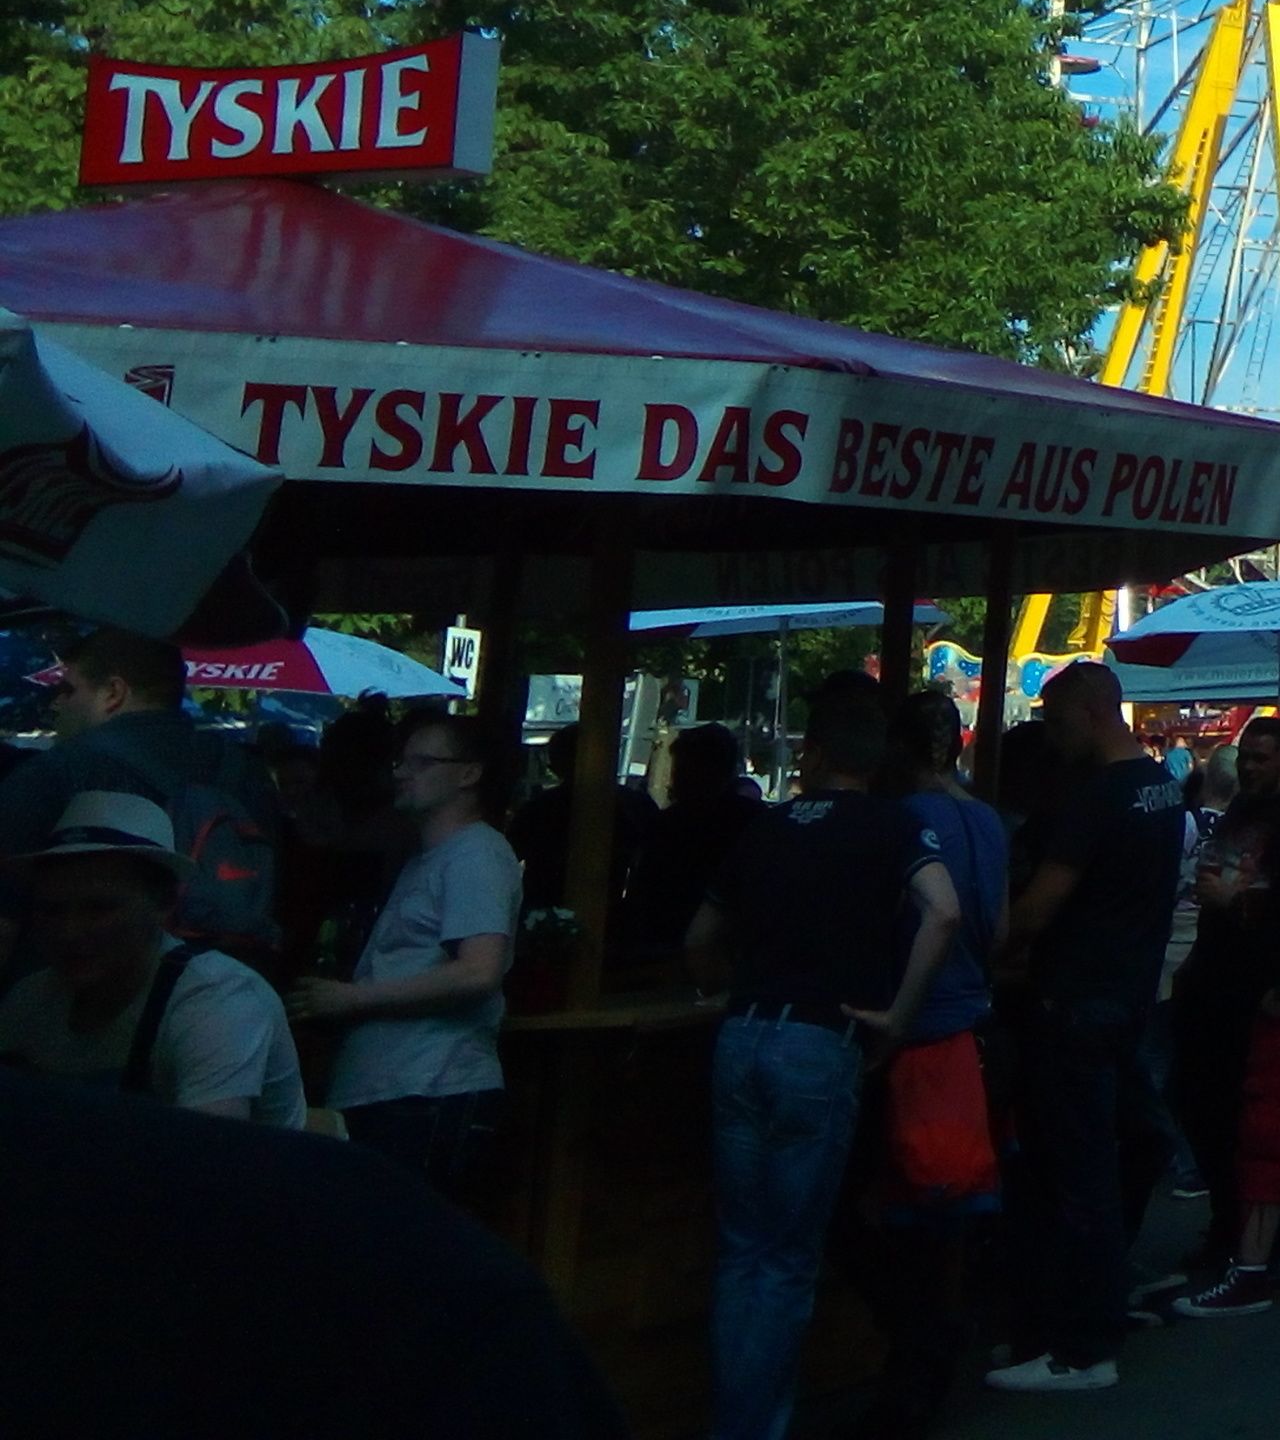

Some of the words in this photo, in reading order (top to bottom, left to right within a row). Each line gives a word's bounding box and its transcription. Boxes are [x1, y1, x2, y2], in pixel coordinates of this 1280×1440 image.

[108, 53, 430, 164] TYSKIE
[240, 382, 601, 481] TYSKIE
[634, 403, 809, 486] DAS
[829, 418, 995, 506] BESTE
[998, 441, 1098, 515] AUS
[1101, 452, 1240, 526] POLEN
[185, 661, 285, 681] YSKIE
[450, 636, 475, 671] WC
